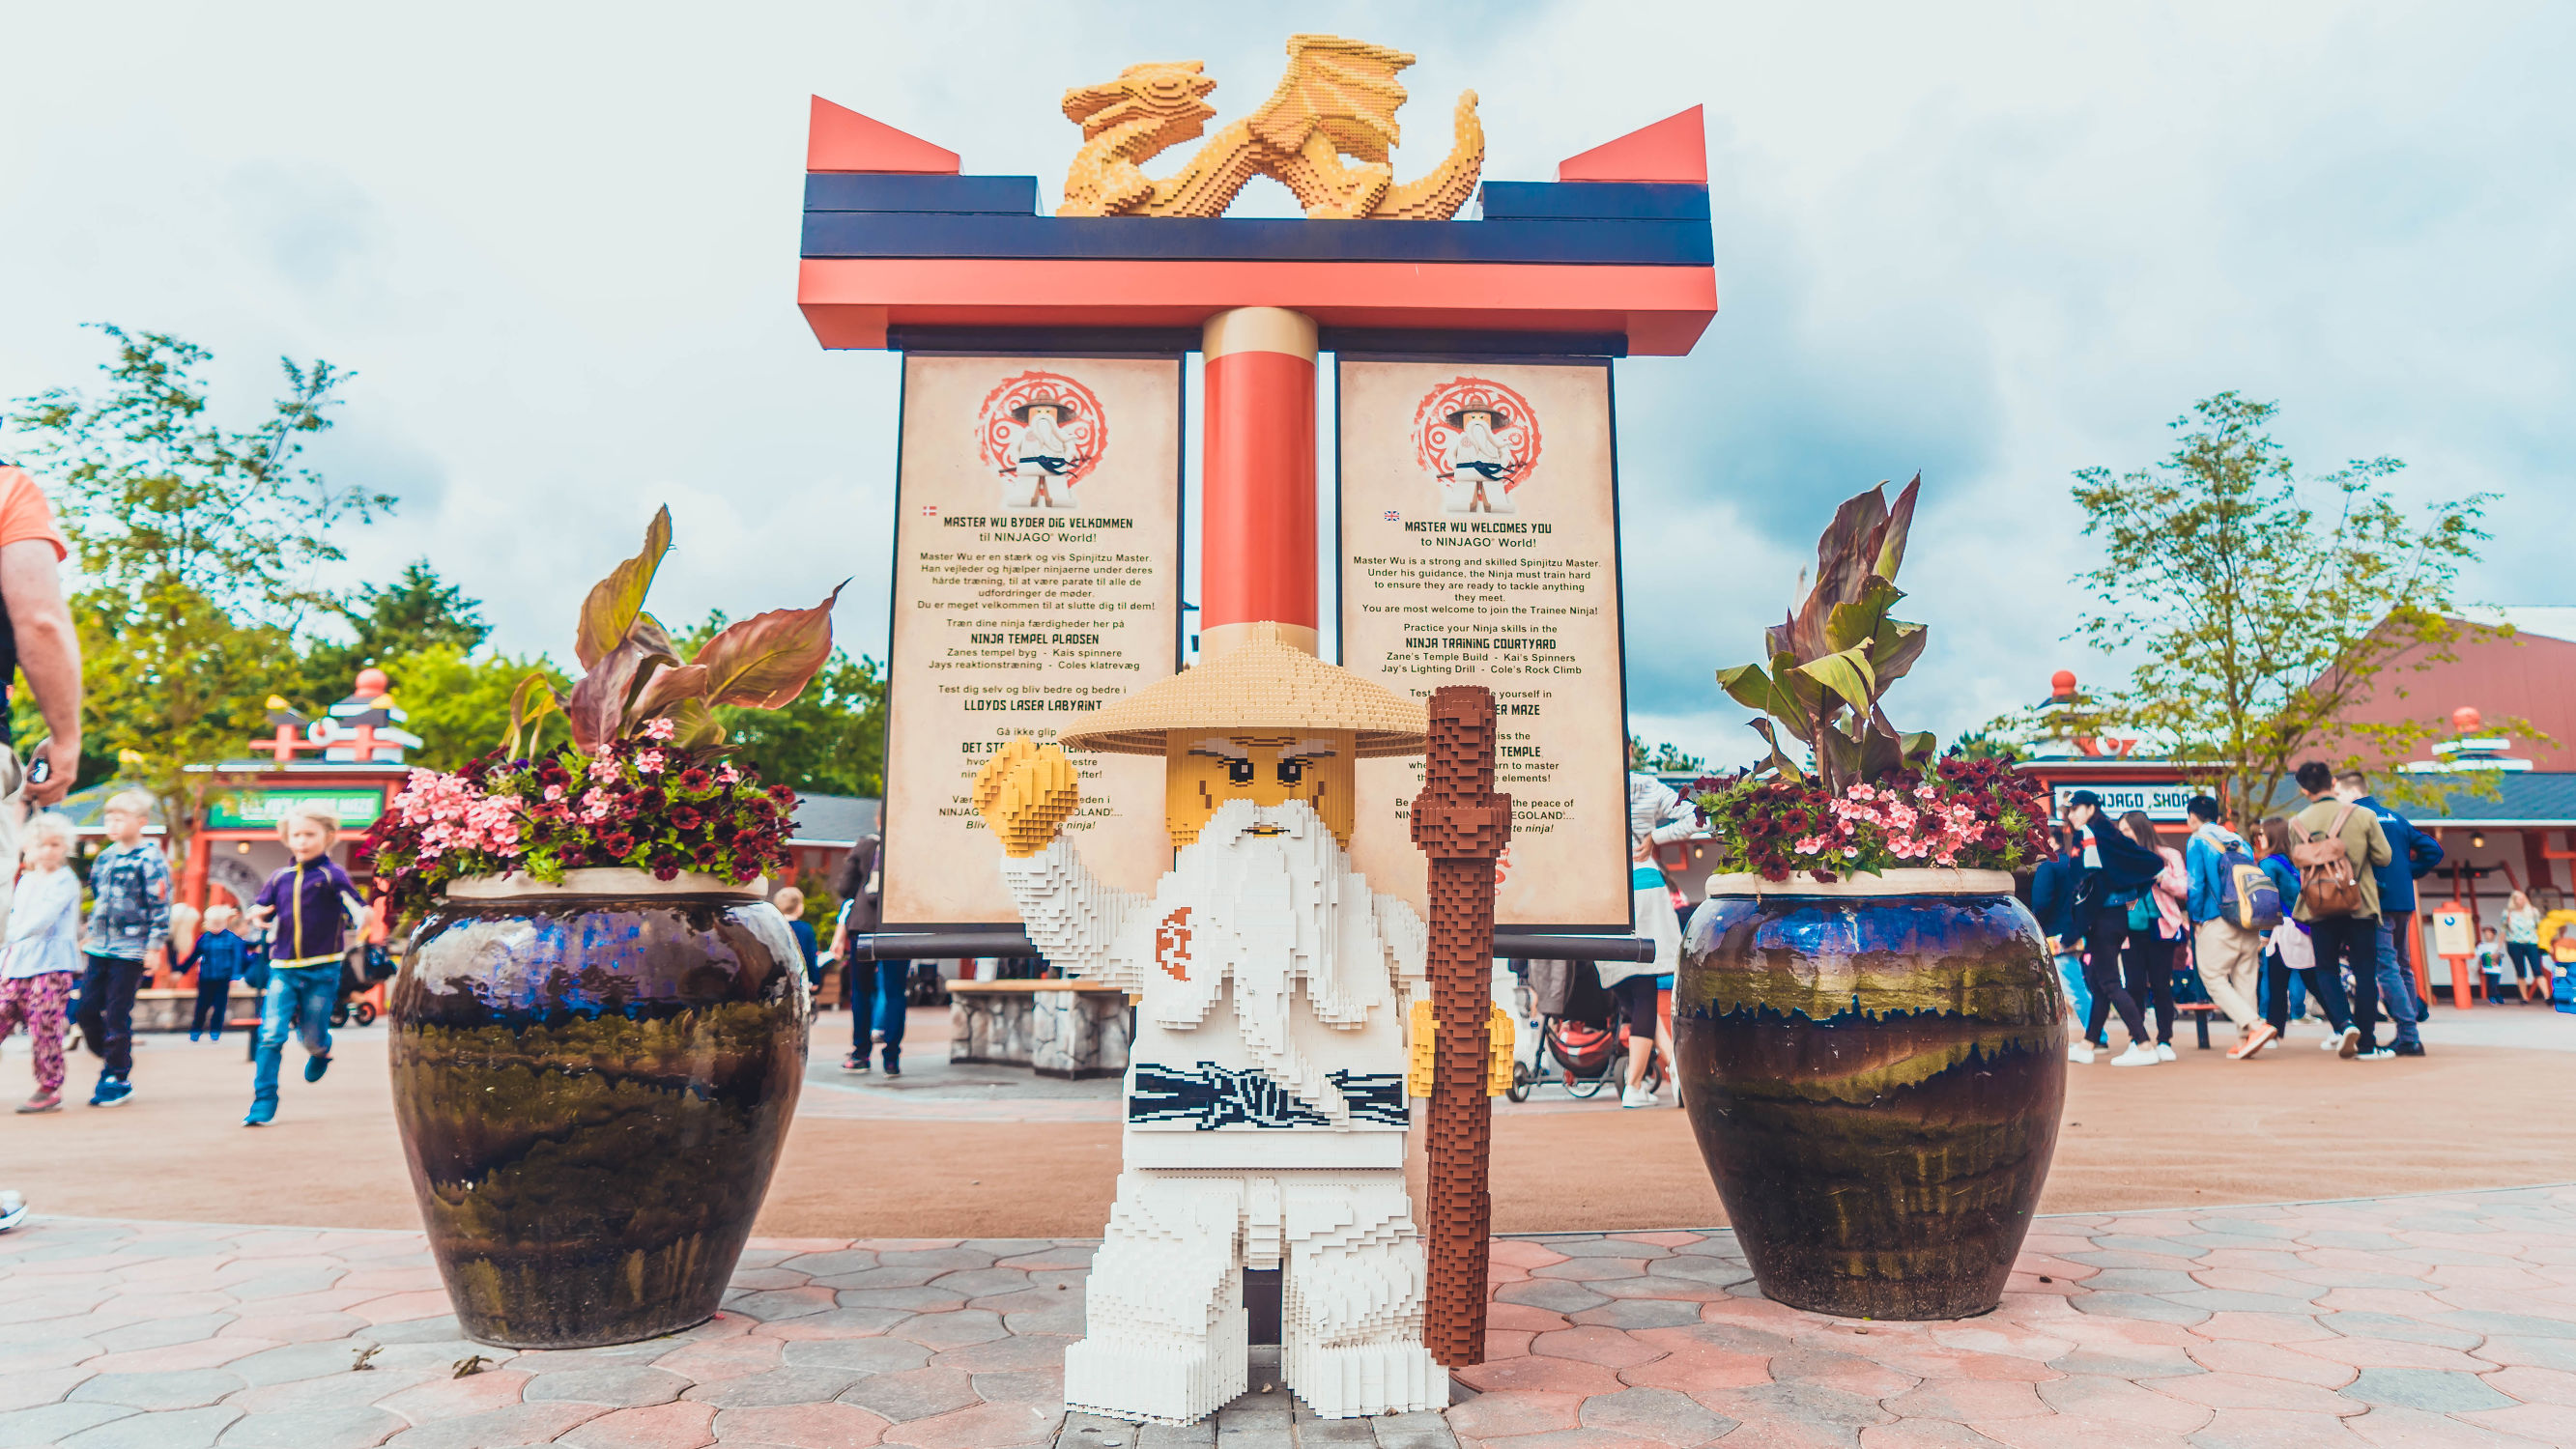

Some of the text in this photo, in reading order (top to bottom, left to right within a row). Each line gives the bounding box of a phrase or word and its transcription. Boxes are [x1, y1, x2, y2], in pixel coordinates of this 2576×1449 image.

[944, 517, 986, 527] MASTER
[990, 517, 1007, 527] WU
[1011, 517, 1045, 527] BYDER
[1070, 518, 1132, 528] VELKOMMEN
[1405, 522, 1552, 533] MASTER WU WELCOMES YOU
[980, 533, 989, 542] til
[1058, 533, 1096, 542] World!
[1421, 537, 1432, 546] to
[1499, 538, 1535, 547] World!
[1070, 554, 1112, 564] Spinjitzu
[1429, 557, 1460, 568] strong
[1521, 558, 1562, 569] Spinjitzu
[945, 564, 983, 575] vejleder
[1003, 565, 1040, 575] hjælper
[1045, 565, 1090, 576] ninjaerne
[1418, 569, 1466, 580] guidance,
[1488, 570, 1513, 581] Ninja
[932, 576, 960, 584] hårde
[963, 577, 1005, 587] træning,
[1062, 578, 1094, 587] parate
[1424, 582, 1445, 591] they
[1467, 582, 1494, 592] ready
[1542, 582, 1585, 593] anything
[979, 589, 1042, 599] udfordringer
[1455, 593, 1475, 604] they
[948, 601, 978, 611] meget
[1099, 602, 1114, 611] dig
[1491, 606, 1508, 616] join
[1570, 607, 1597, 617] Ninja!
[1001, 619, 1024, 630] ninja
[1029, 619, 1090, 630] færdigheder
[1113, 619, 1124, 630] på
[1473, 624, 1498, 635] Ninja
[971, 633, 1100, 644] NINJA TEMPEL PLADSEN
[1406, 638, 1438, 648] NINJA
[1494, 639, 1556, 649] COURTYARD
[982, 648, 1015, 659] tempel
[1018, 648, 1036, 659] byg
[1078, 649, 1122, 659] spinnere
[1423, 653, 1459, 663] Temple
[1532, 654, 1575, 664] Spinners
[929, 661, 952, 670] Jays
[956, 661, 1042, 671] reaktionstræning
[1090, 661, 1139, 671] klatrevæg
[1382, 665, 1407, 674] Jay's
[1411, 665, 1451, 675] Lighting
[963, 685, 978, 696] dig
[1007, 687, 1018, 696] og
[1410, 689, 1431, 697] Test
[964, 700, 1007, 711] LLOYDS
[1011, 700, 1044, 711] LASER
[1512, 705, 1540, 715] MAZE
[1038, 727, 1056, 738] glip
[962, 743, 982, 753] DET
[1067, 821, 1095, 830] ninja!
[1526, 825, 1554, 834] ninja!
